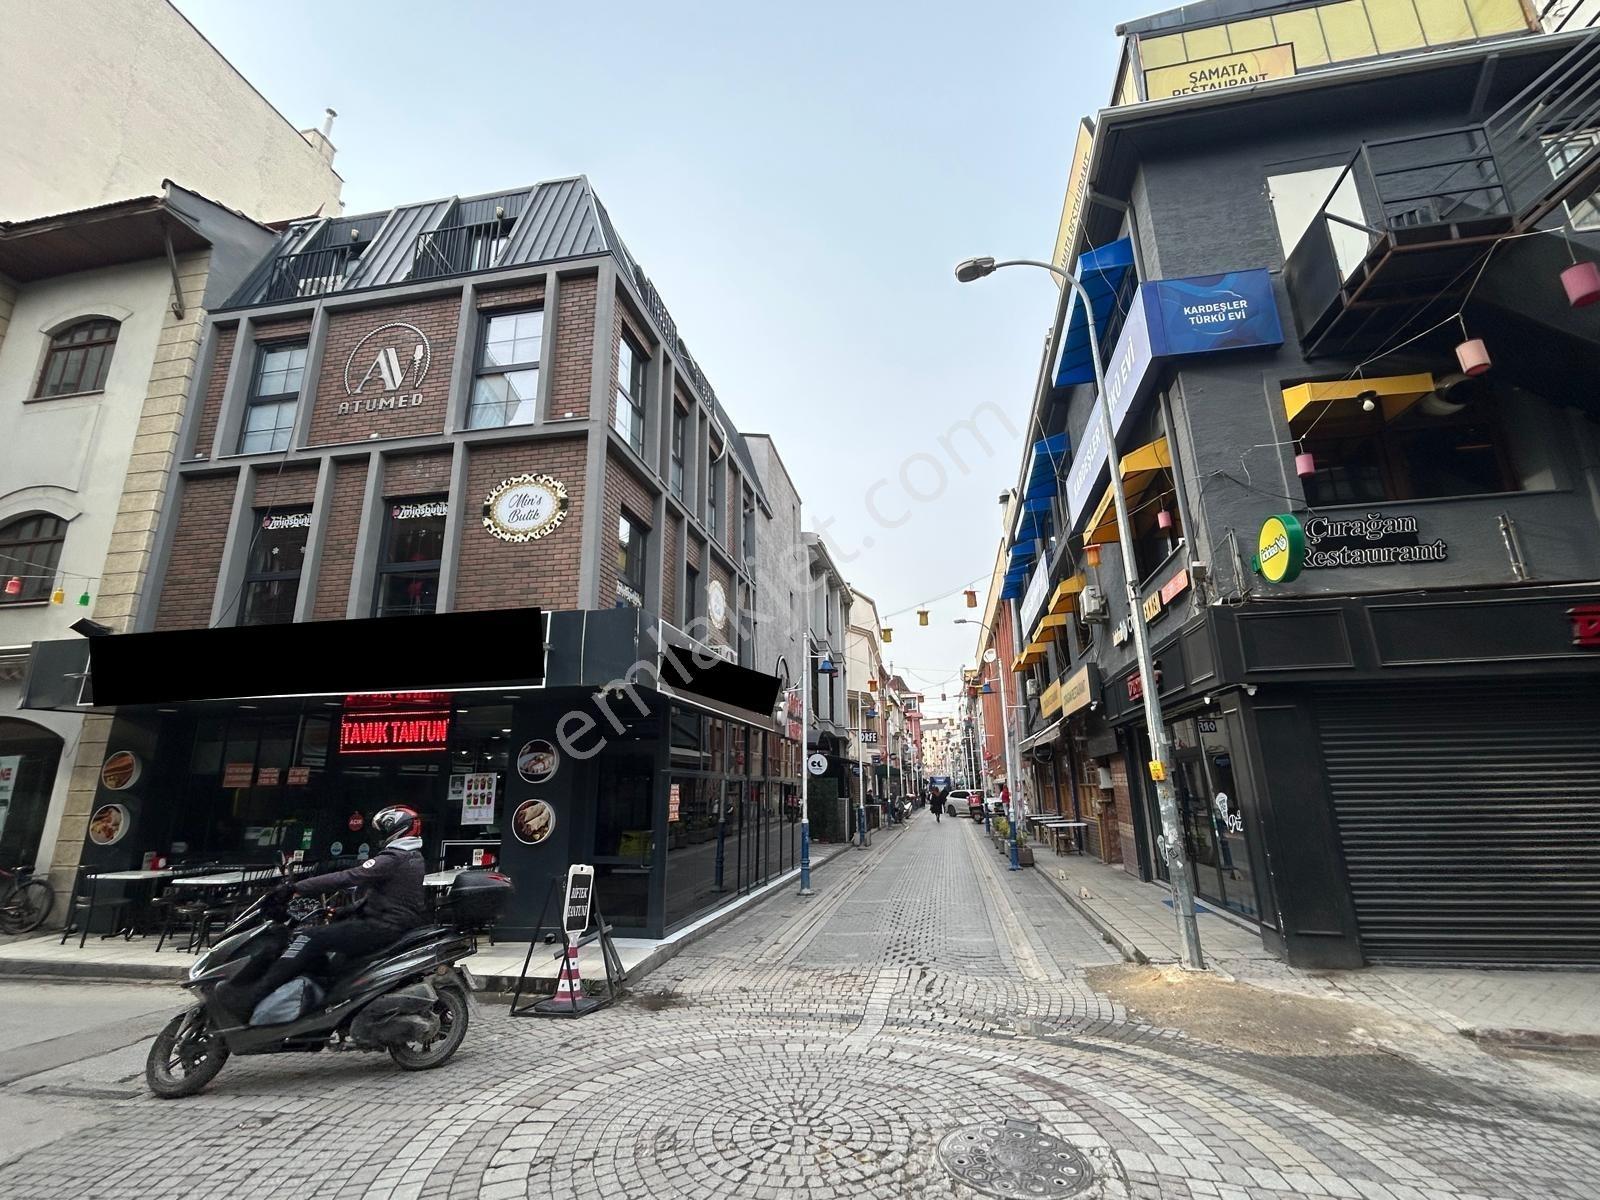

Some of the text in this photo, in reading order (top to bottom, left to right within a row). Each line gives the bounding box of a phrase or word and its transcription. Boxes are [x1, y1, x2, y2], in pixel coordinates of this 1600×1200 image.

[1189, 62, 1248, 84] ŞAMATA
[1183, 300, 1248, 316] KARDEŞLER
[1189, 309, 1246, 325] TÜRKÜ EVİ
[1120, 336, 1136, 384] EVİ
[338, 393, 423, 416] ATUMED
[508, 493, 543, 509] Min's
[507, 508, 541, 523] Butik
[1305, 513, 1418, 544] Çırağan
[1302, 540, 1447, 568] Restaurant
[343, 721, 389, 744] TAVUK
